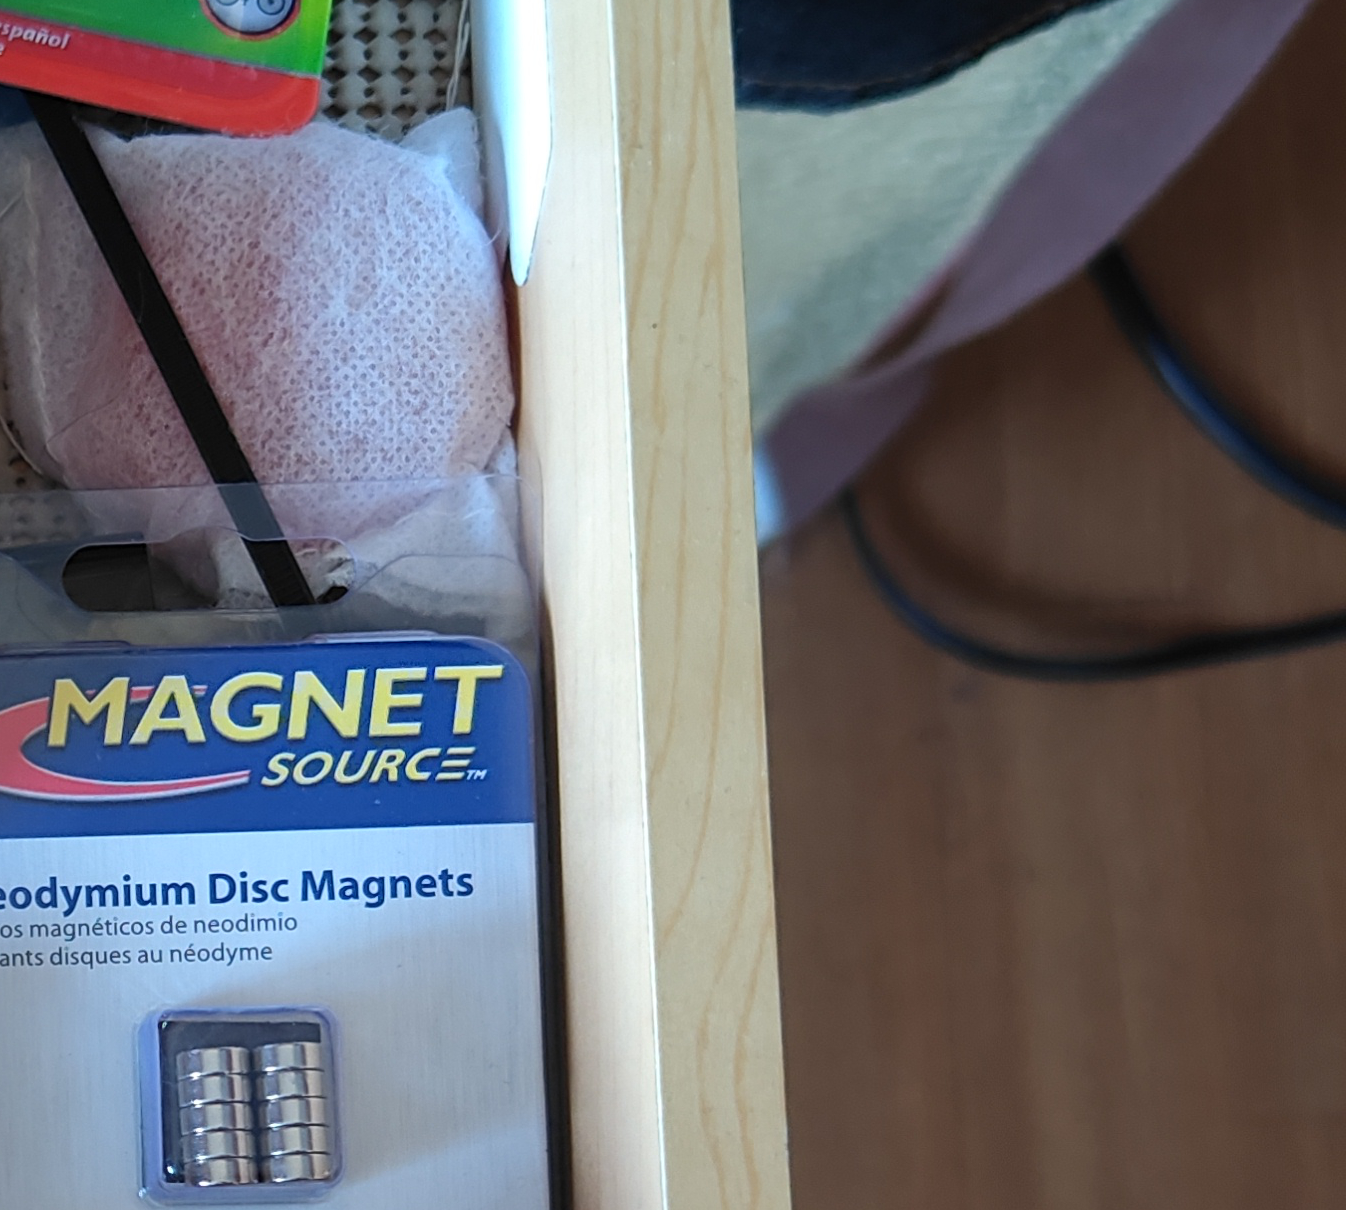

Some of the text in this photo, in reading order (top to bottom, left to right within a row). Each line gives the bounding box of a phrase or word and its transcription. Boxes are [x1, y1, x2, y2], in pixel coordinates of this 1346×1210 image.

[47, 664, 503, 748] MAGNET
[261, 746, 477, 786] SOURCE
[209, 871, 290, 904] Disc
[301, 868, 474, 908] Magnets
[30, 918, 154, 941] magnéticos
[160, 916, 187, 934] de
[194, 913, 297, 933] neodimio
[50, 947, 131, 970] disques
[138, 948, 162, 965] au
[170, 942, 273, 967] néodyme
